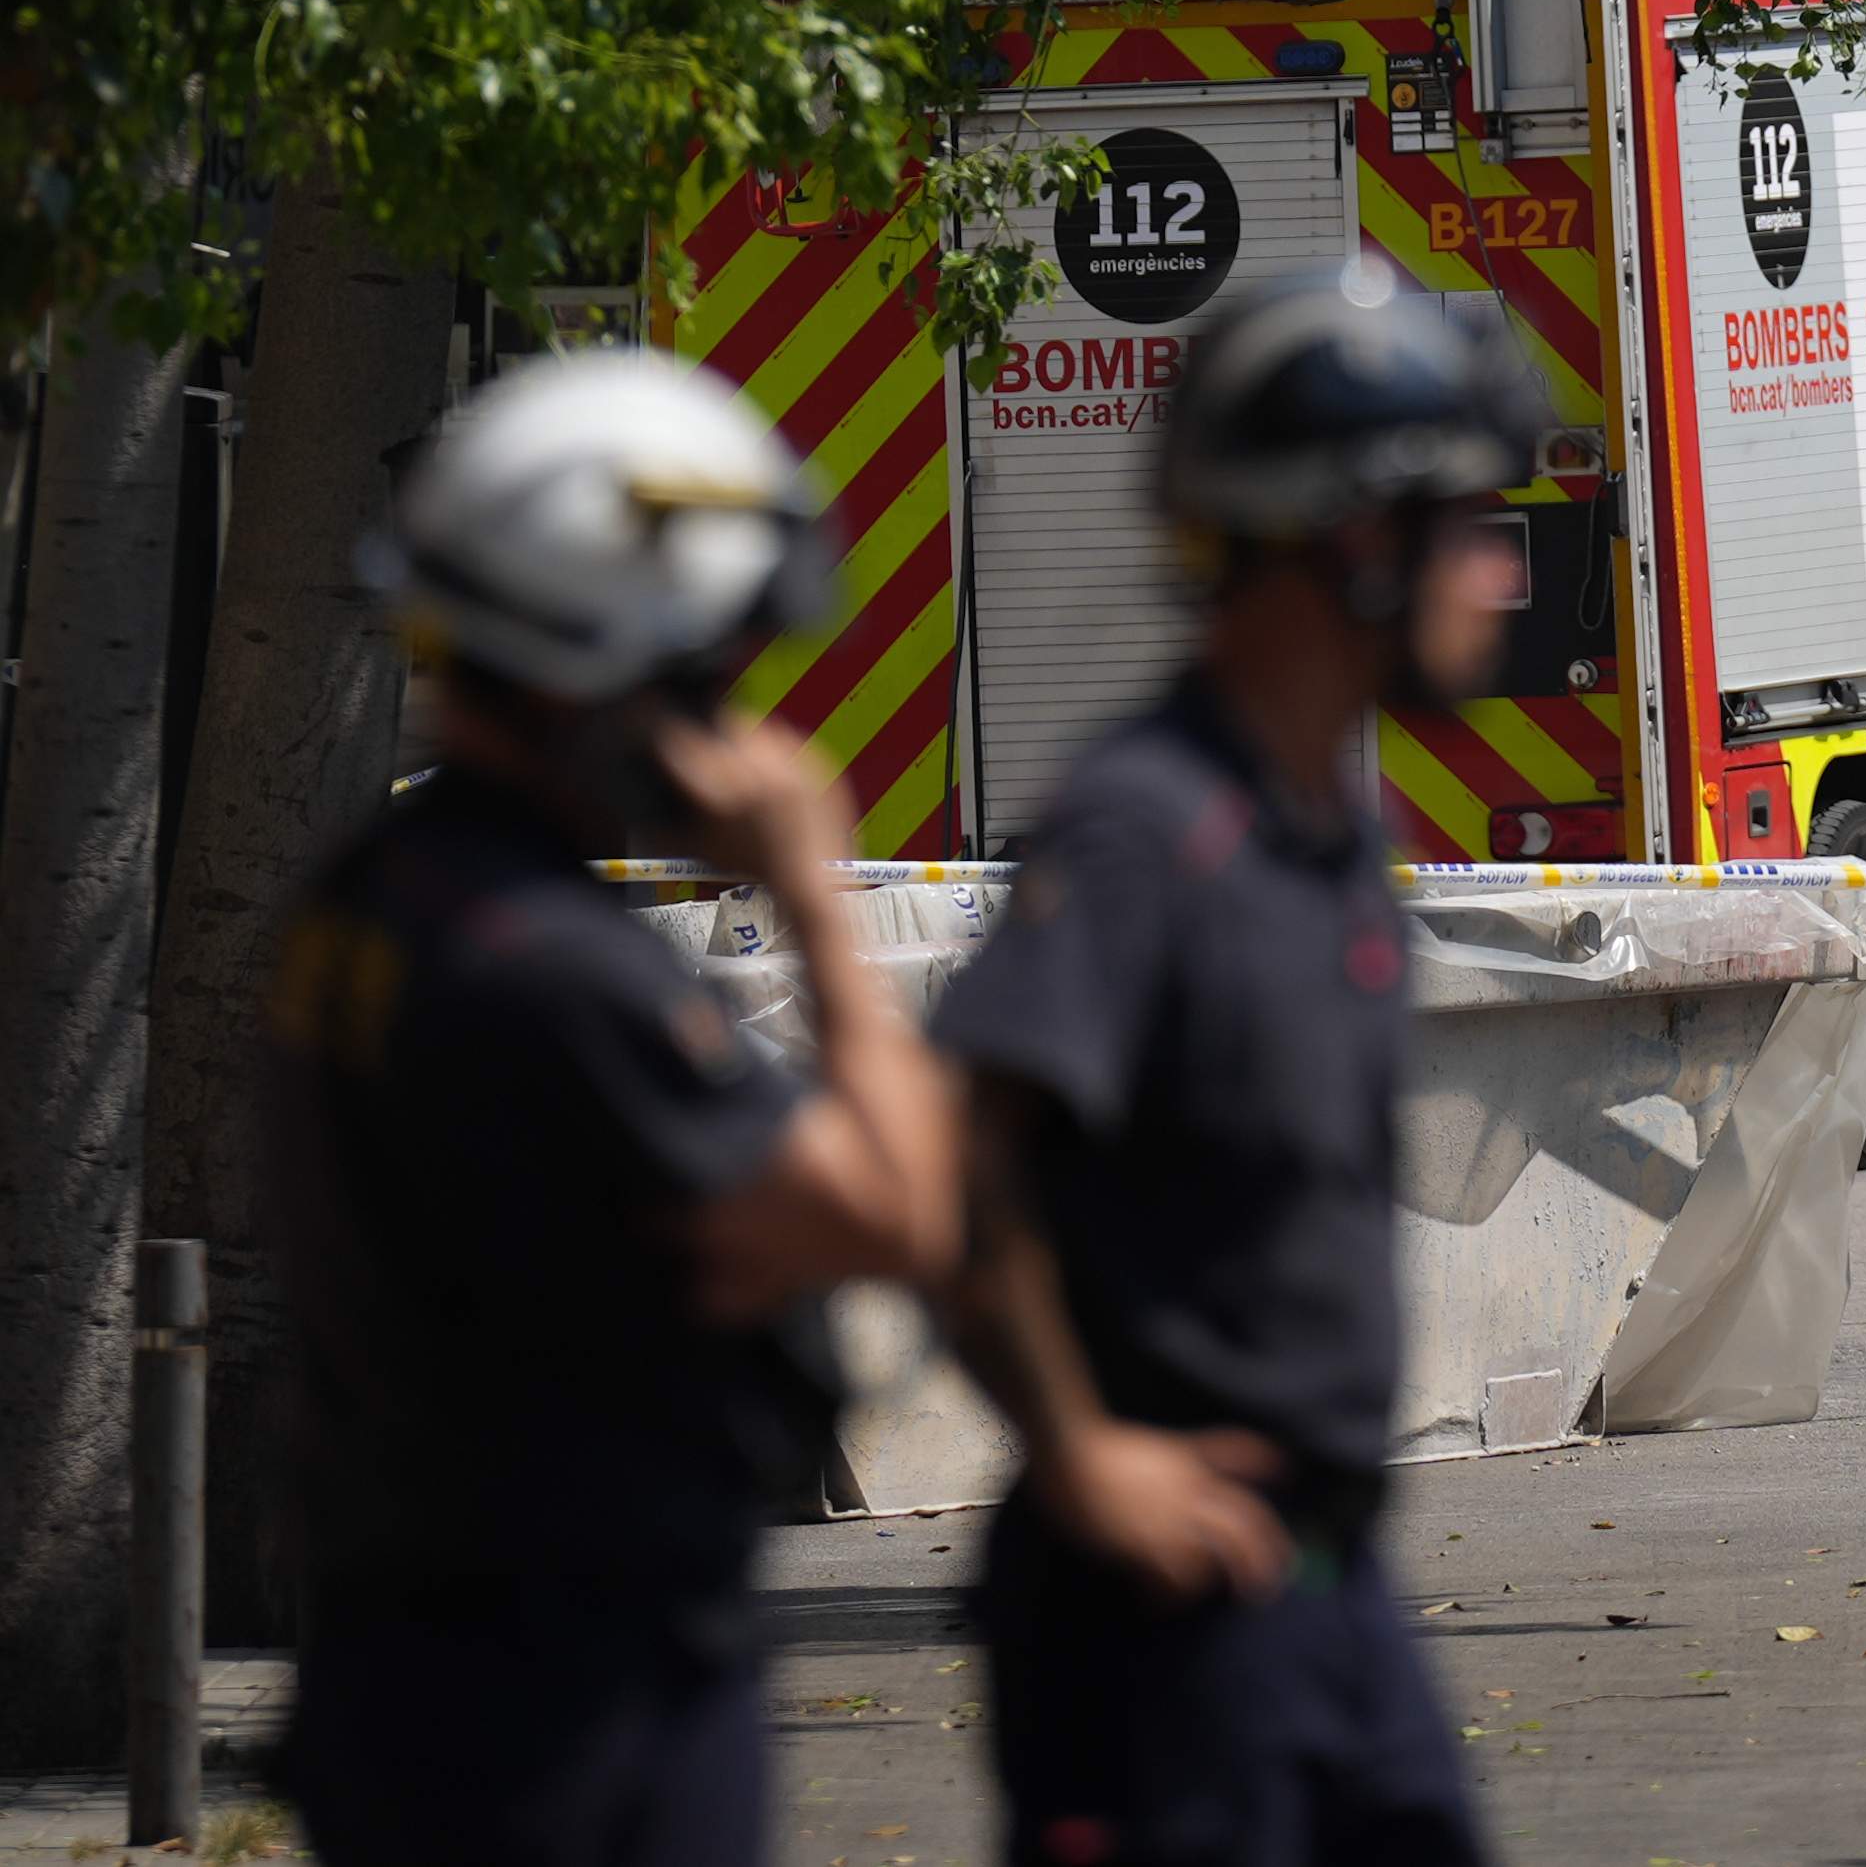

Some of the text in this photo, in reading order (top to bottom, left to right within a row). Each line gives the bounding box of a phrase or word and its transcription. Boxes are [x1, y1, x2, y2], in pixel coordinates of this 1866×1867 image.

[1749, 123, 1800, 201] 112
[1090, 180, 1206, 246] 112
[1430, 198, 1578, 250] B-127
[1090, 253, 1206, 275] emergències
[1724, 300, 1849, 371] BOMBERS
[993, 337, 1198, 394] BOMB
[1729, 370, 1853, 417] bcn.cat/bombers
